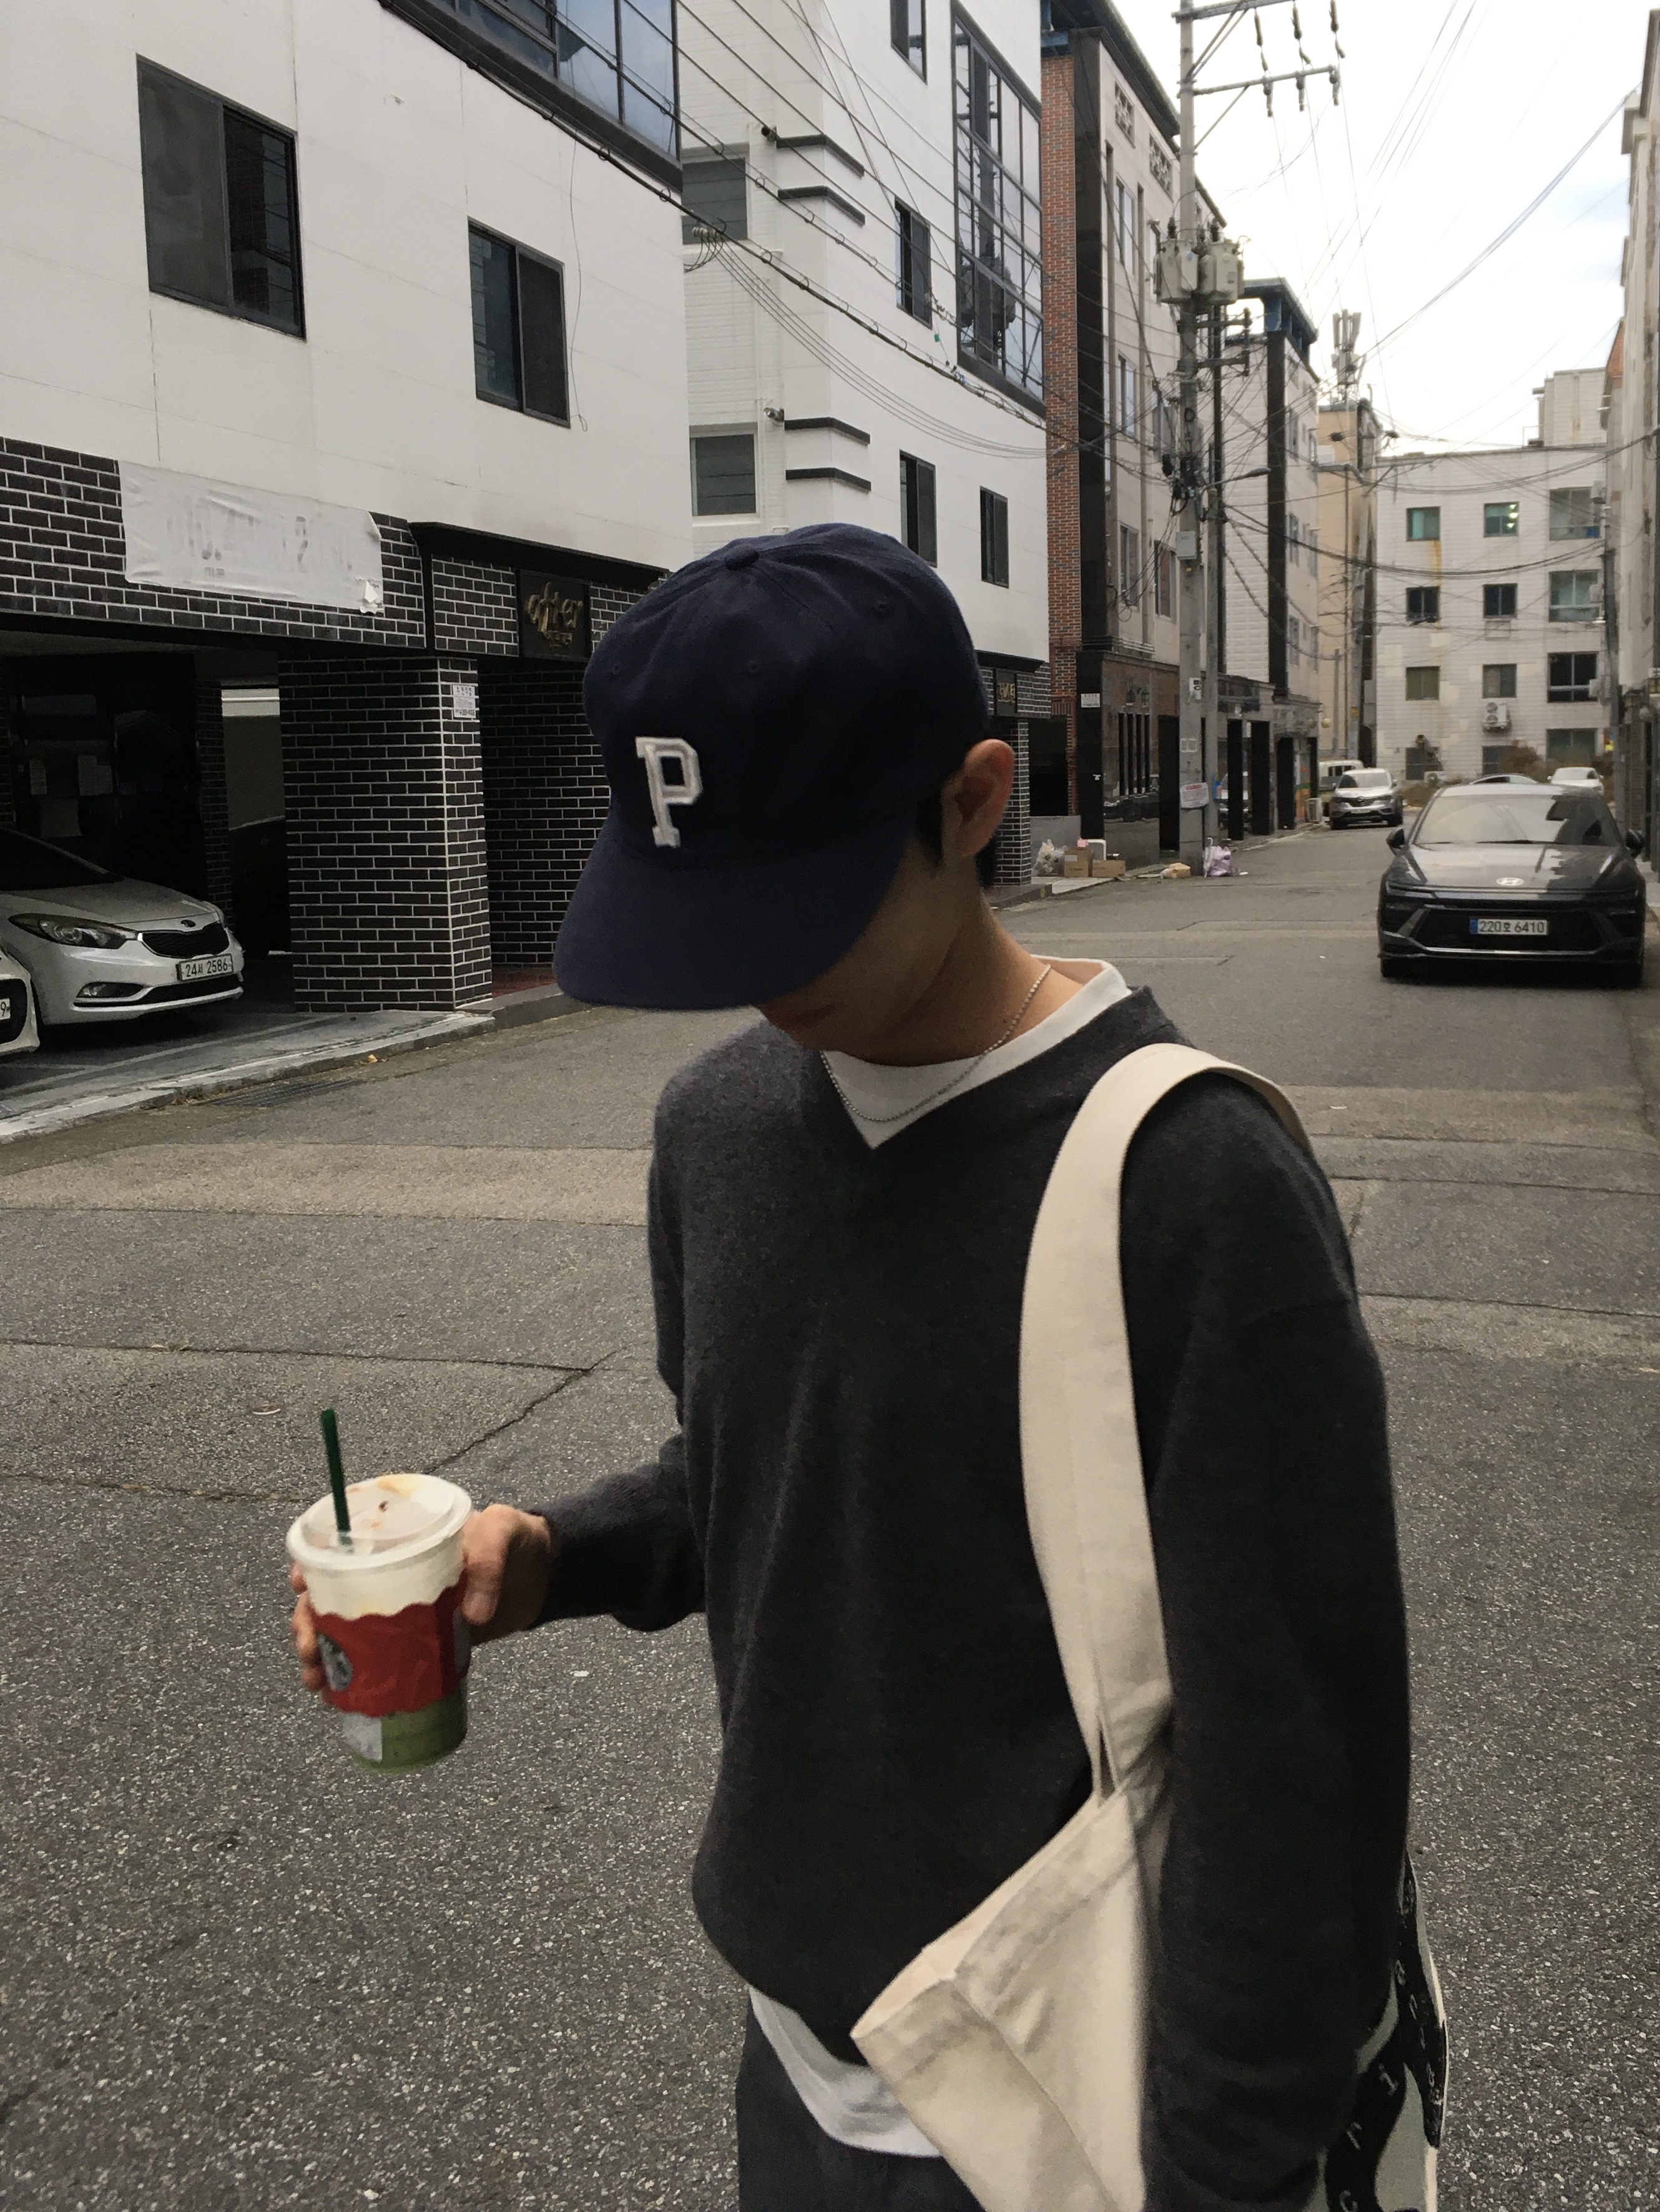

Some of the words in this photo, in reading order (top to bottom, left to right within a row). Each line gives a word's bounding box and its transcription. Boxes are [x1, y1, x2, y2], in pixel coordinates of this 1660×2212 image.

[523, 581, 583, 632] after
[634, 736, 703, 849] P
[1514, 921, 1545, 933] 6410
[207, 959, 228, 974] 2586
